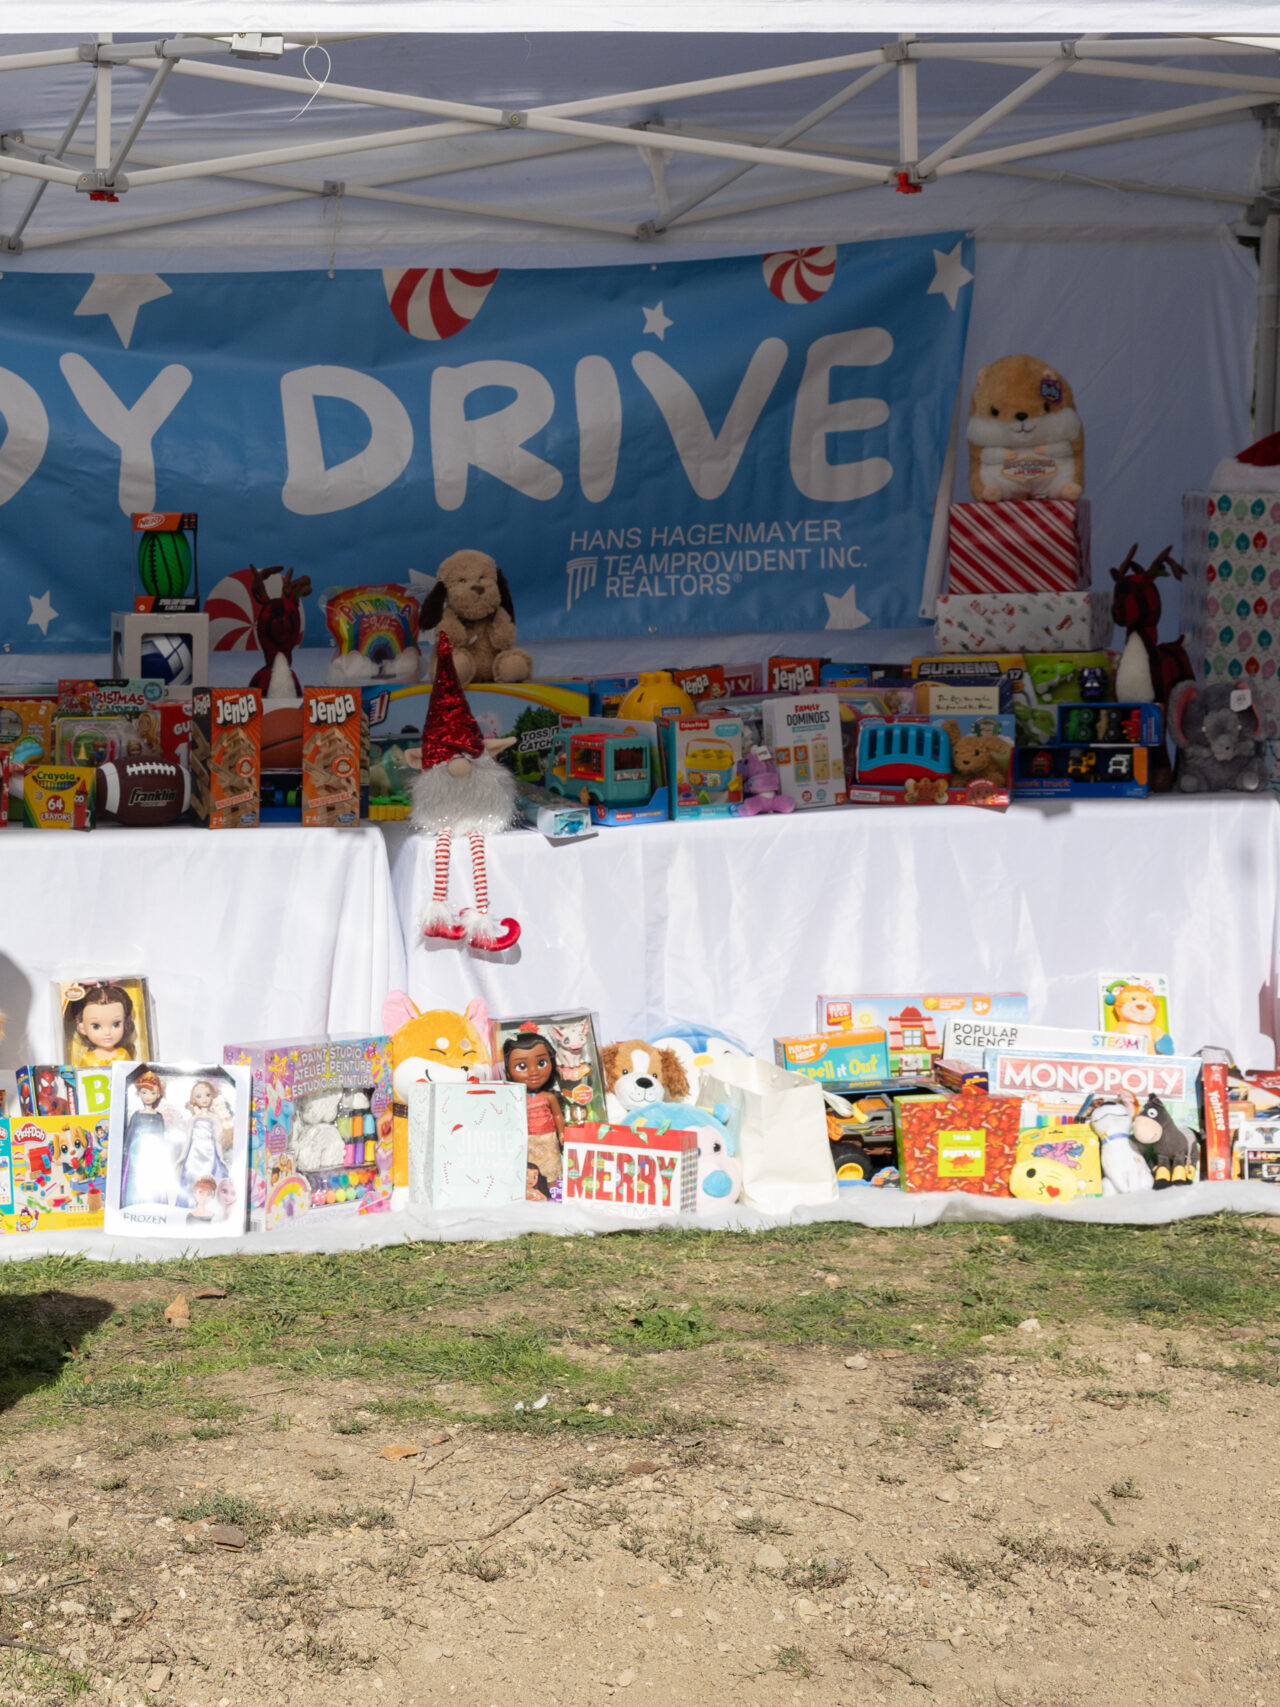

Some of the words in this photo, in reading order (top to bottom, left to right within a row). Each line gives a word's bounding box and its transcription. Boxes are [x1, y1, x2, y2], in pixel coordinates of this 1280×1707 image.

[280, 326, 894, 516] DRIVE
[570, 528, 642, 551] HANS
[650, 519, 842, 547] HAGENMAYER
[604, 549, 811, 576] TEAMPROVIDENT
[820, 546, 869, 569] INC.
[772, 664, 815, 692] Jenga
[920, 661, 1000, 675] SUPREME
[216, 694, 257, 724] Jenga
[309, 694, 356, 724] Jenga
[786, 711, 830, 726] DOMINOES
[794, 704, 820, 713] FAMILY
[36, 770, 76, 782] Crayola
[47, 799, 64, 811] 64
[128, 786, 177, 806] Franklin
[953, 1023, 1018, 1038] POPULAR
[955, 1034, 1016, 1048] SCIENCE
[301, 1049, 328, 1065] PAINT
[330, 1045, 362, 1060] STUDIO
[849, 1054, 878, 1075] Out
[293, 1062, 327, 1082] ATELIER
[329, 1060, 371, 1073] PEINTURE
[1004, 1061, 1184, 1099] MONOPOLY
[292, 1077, 327, 1097] ESTUDIO
[567, 1148, 678, 1207] MERRY
[123, 1213, 167, 1225] FROZEN
